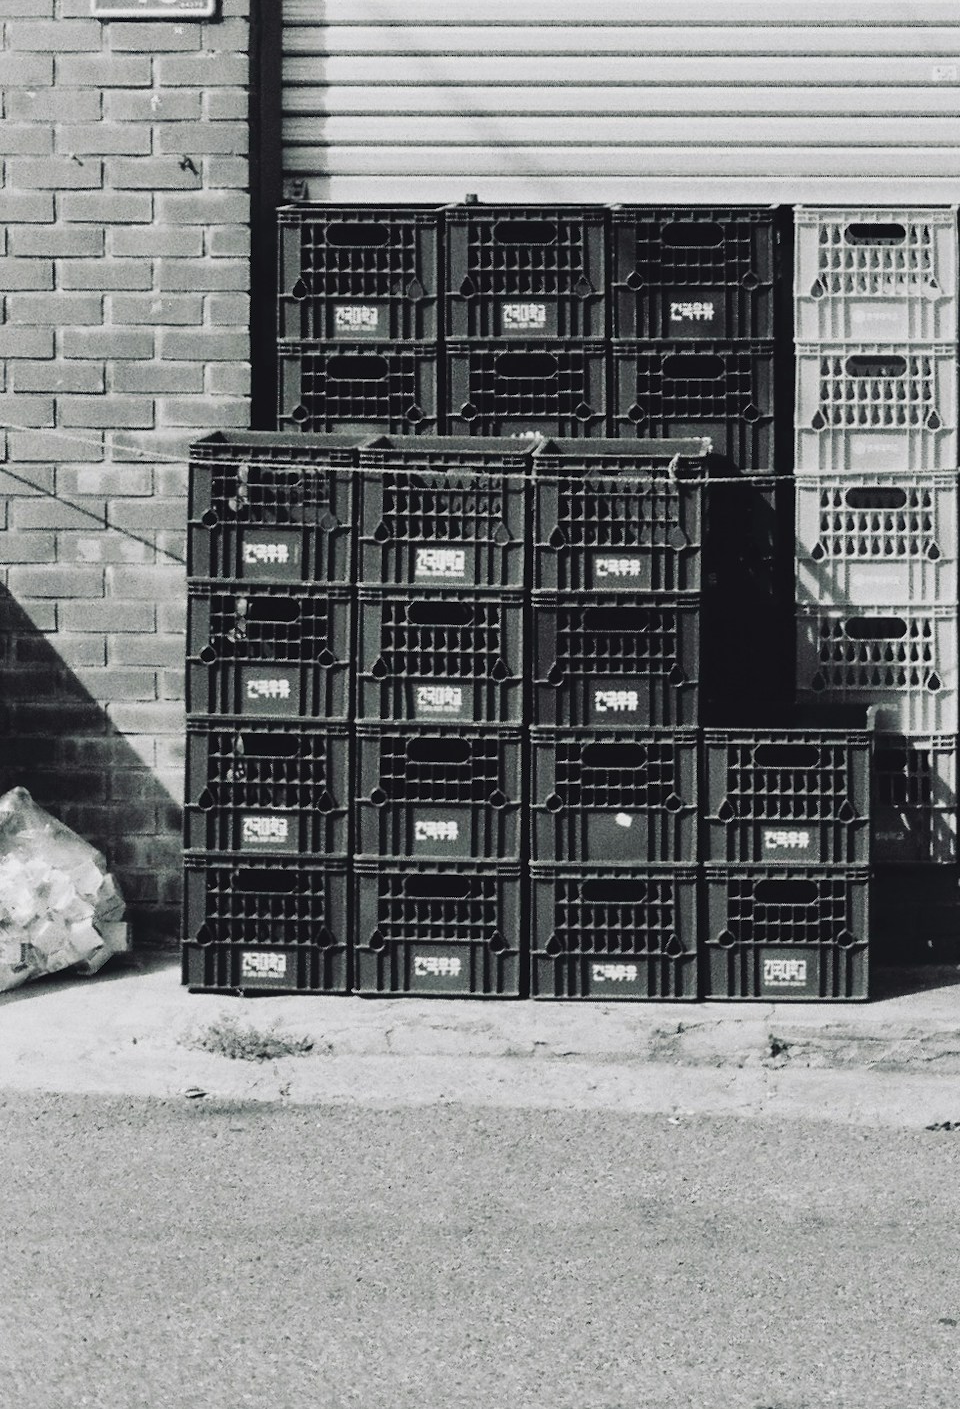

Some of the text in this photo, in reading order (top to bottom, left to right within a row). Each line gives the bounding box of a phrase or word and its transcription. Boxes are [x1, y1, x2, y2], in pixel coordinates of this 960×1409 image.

[334, 306, 379, 325] 건국대학교
[502, 303, 547, 322] 건국대학교
[671, 302, 715, 321] 건국우유
[243, 544, 290, 563] 건국우유
[415, 549, 466, 570] 건국대학교
[595, 559, 641, 577] 건국우유
[247, 679, 291, 698] 건국우유
[416, 687, 463, 705] 건국대학교
[595, 690, 639, 711] 건국우유
[243, 816, 288, 836] 건국대학교
[415, 821, 459, 840] 건국우유
[764, 830, 809, 849] 건국우유
[242, 952, 287, 971] 건국대학교
[415, 957, 462, 977] 건국우유
[592, 964, 638, 981] 건국우유
